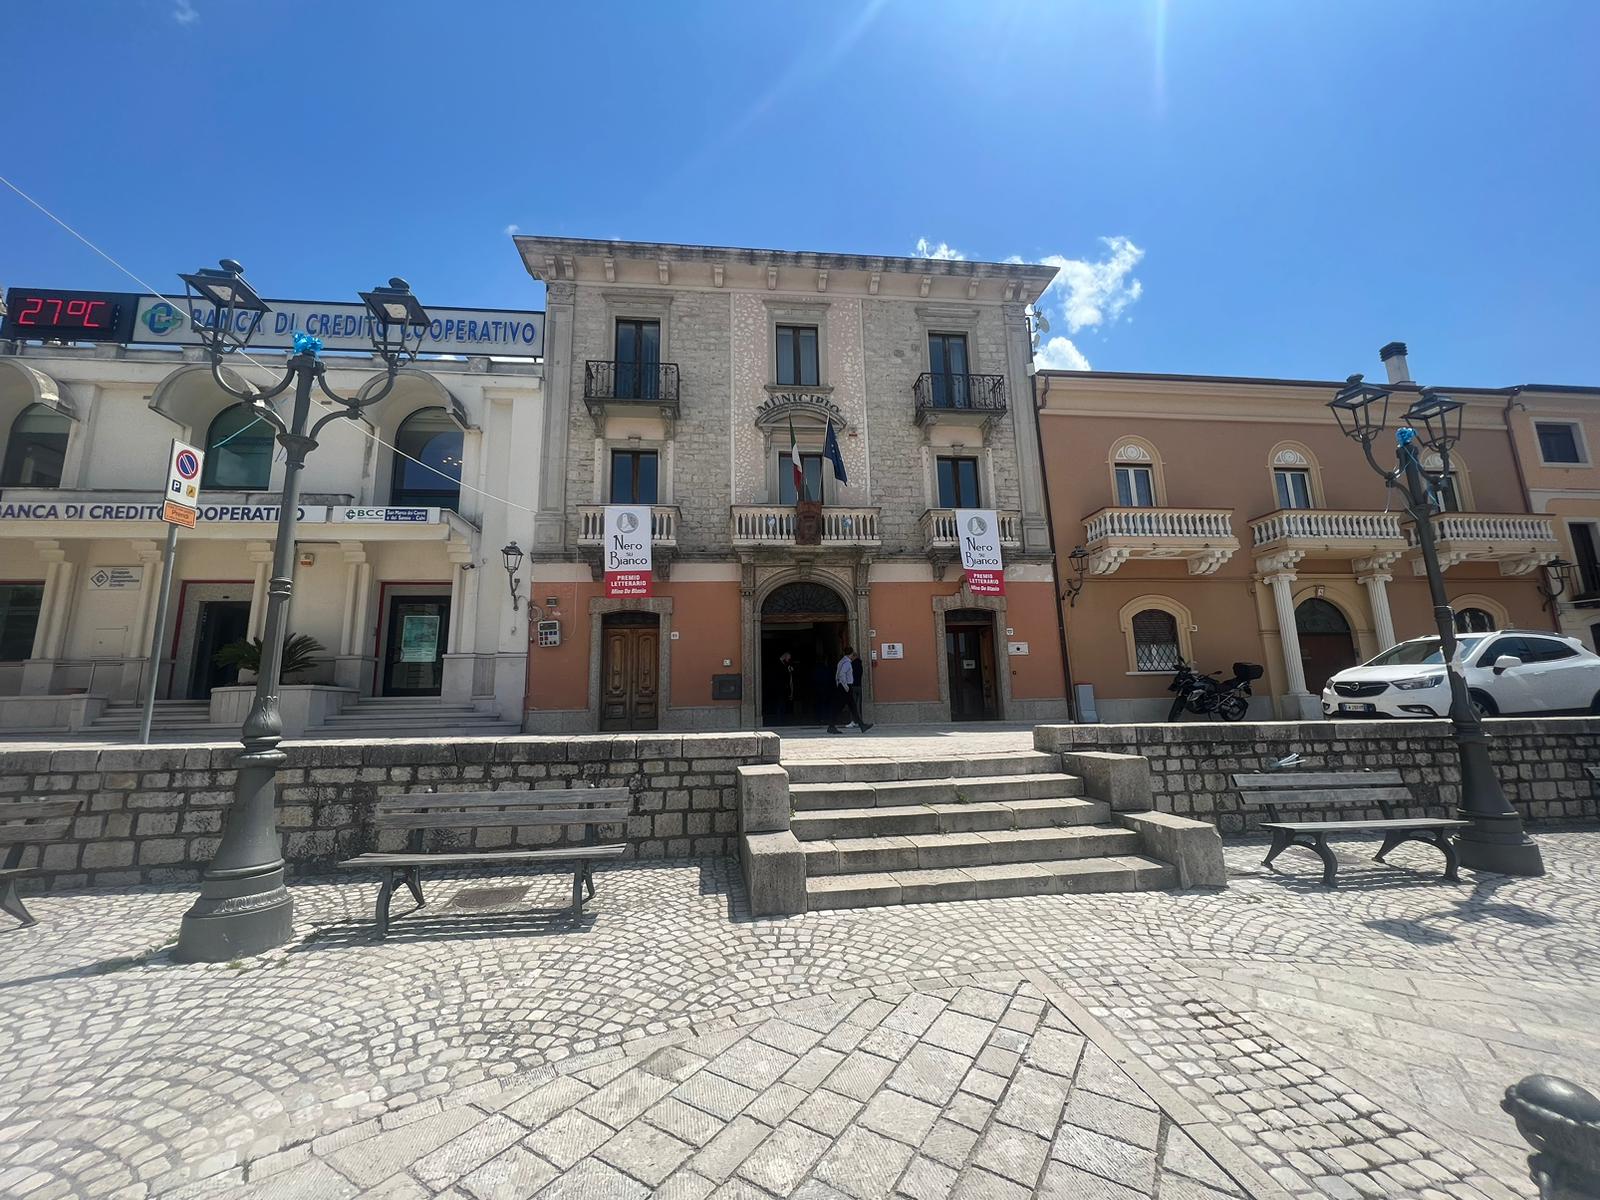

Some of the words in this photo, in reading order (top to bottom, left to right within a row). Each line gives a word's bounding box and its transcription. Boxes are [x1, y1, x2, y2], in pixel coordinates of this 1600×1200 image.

[18, 298, 106, 327] 27°C
[274, 312, 296, 334] DI
[756, 393, 841, 414] MUNICIPIO
[0, 503, 59, 519] ANCA
[65, 504, 85, 519] DI
[357, 509, 384, 517] BCC
[613, 534, 643, 550] Nero
[966, 537, 993, 551] Nero
[609, 550, 648, 569] Bianco
[965, 551, 999, 568] Bianco
